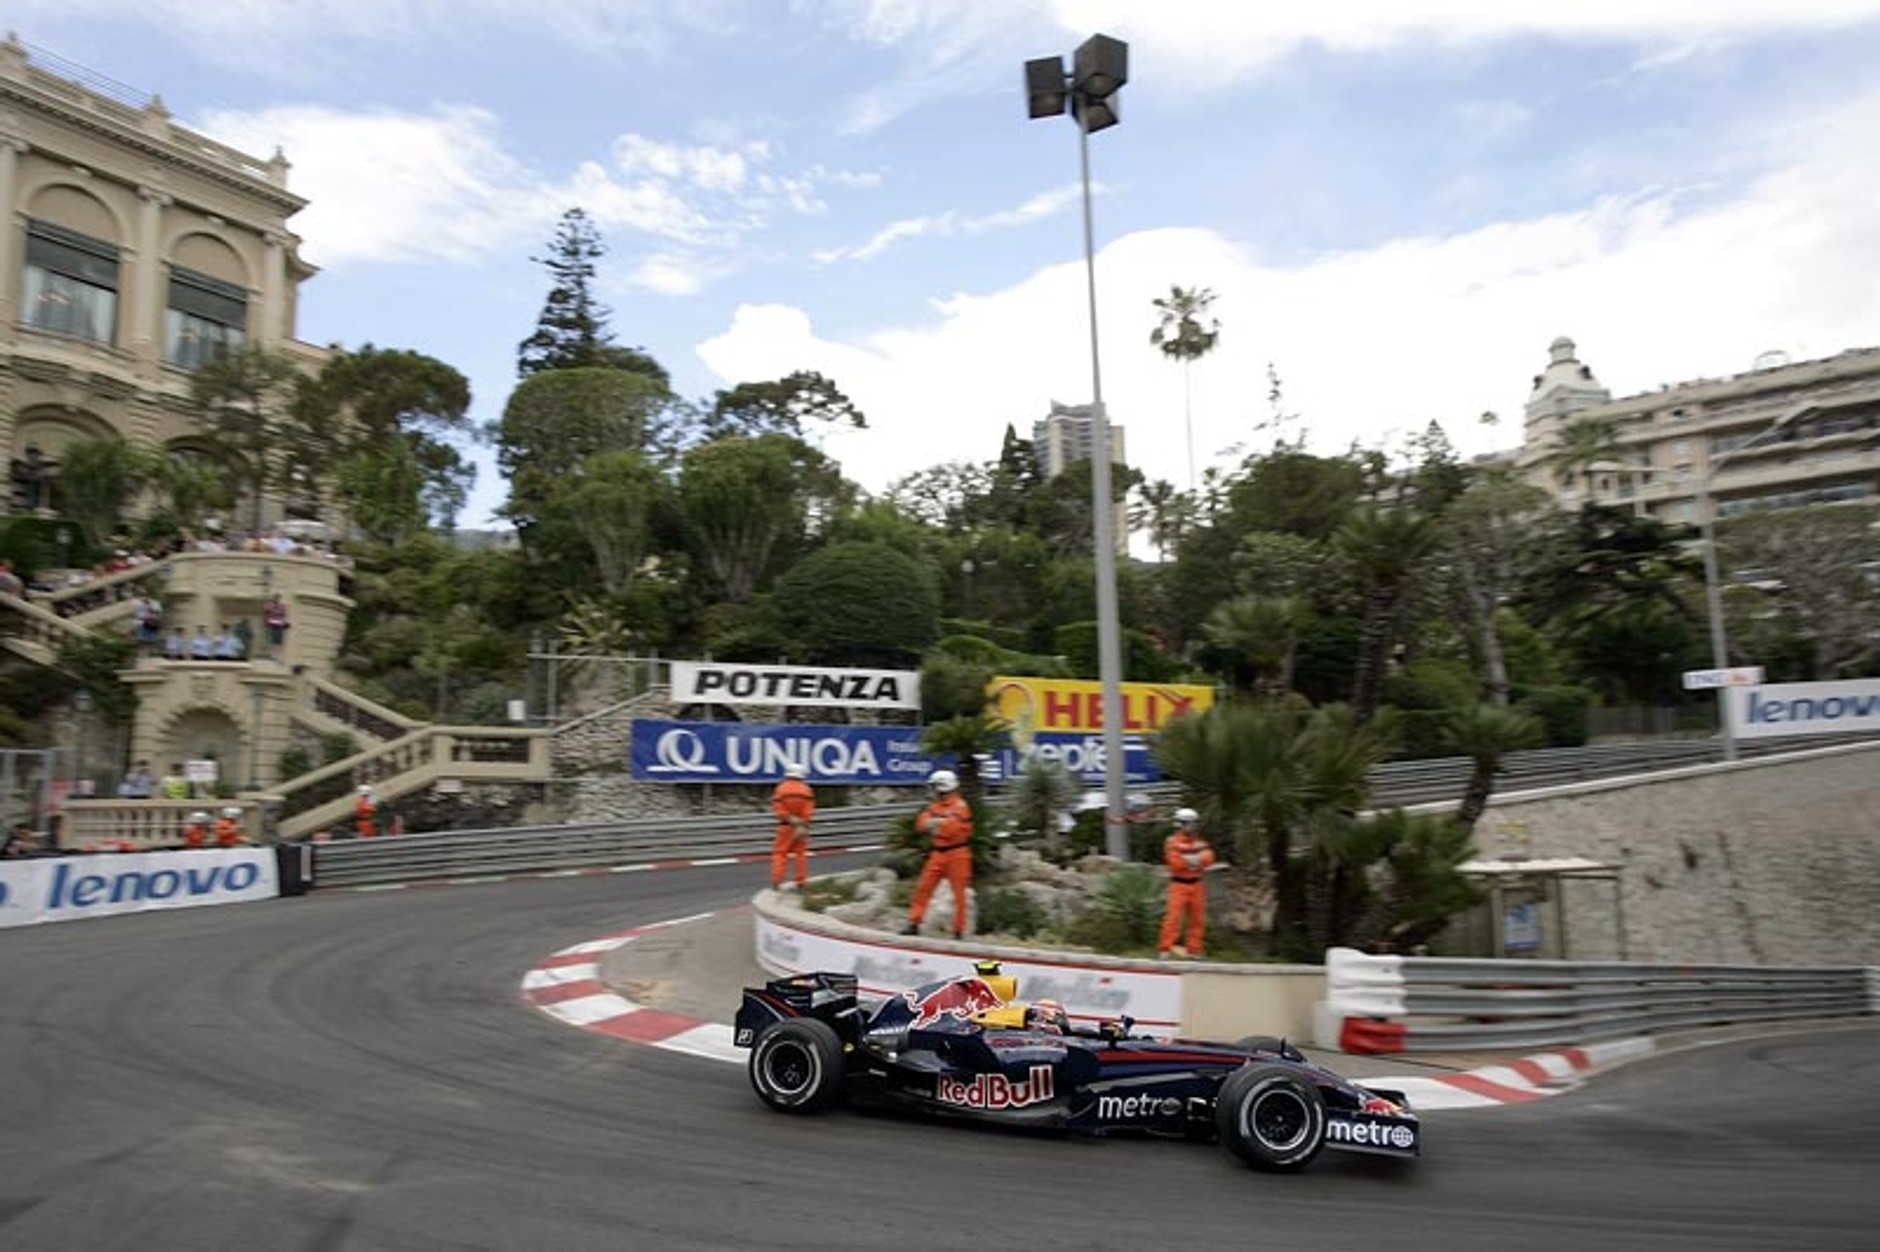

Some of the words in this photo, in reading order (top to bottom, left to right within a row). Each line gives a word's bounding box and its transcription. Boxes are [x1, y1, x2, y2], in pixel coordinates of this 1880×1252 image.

[694, 669, 900, 701] POTENZA
[725, 735, 882, 776] UNIQA
[46, 862, 260, 909] lenovo
[1325, 1120, 1415, 1149] metro
